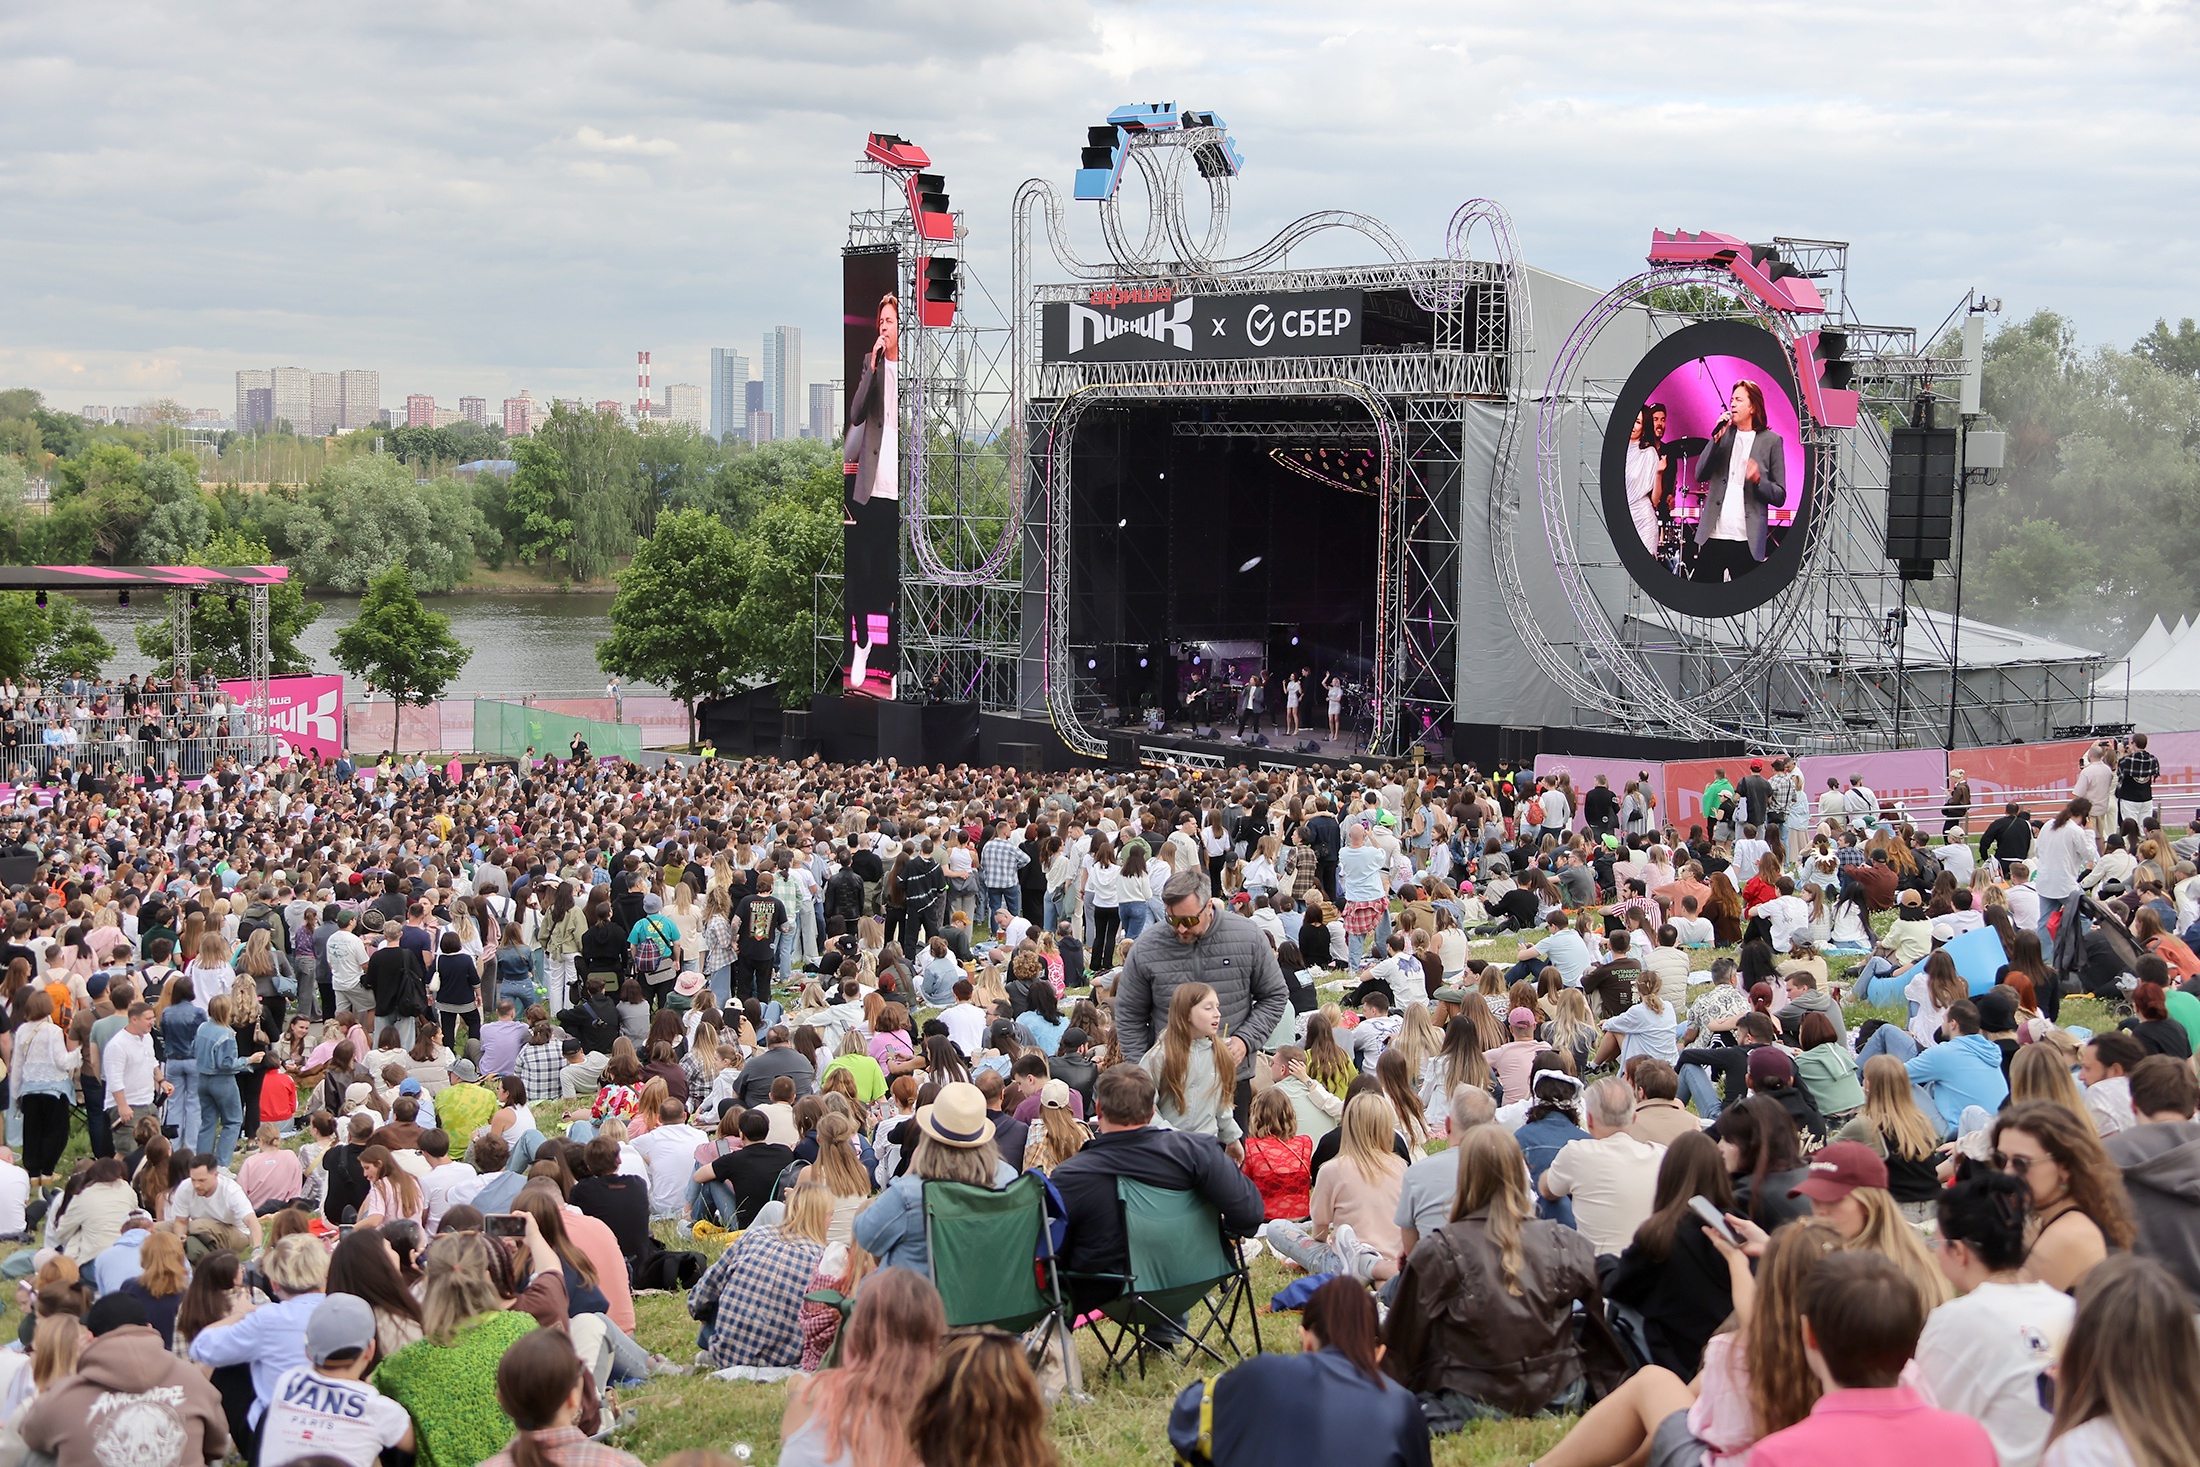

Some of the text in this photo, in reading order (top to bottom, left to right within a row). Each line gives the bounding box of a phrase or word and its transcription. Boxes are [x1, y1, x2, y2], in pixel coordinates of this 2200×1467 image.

[1090, 283, 1171, 310] афиша
[1282, 308, 1351, 337] СБЕР
[283, 1372, 368, 1418] VANS
[290, 1416, 334, 1430] PARIS
